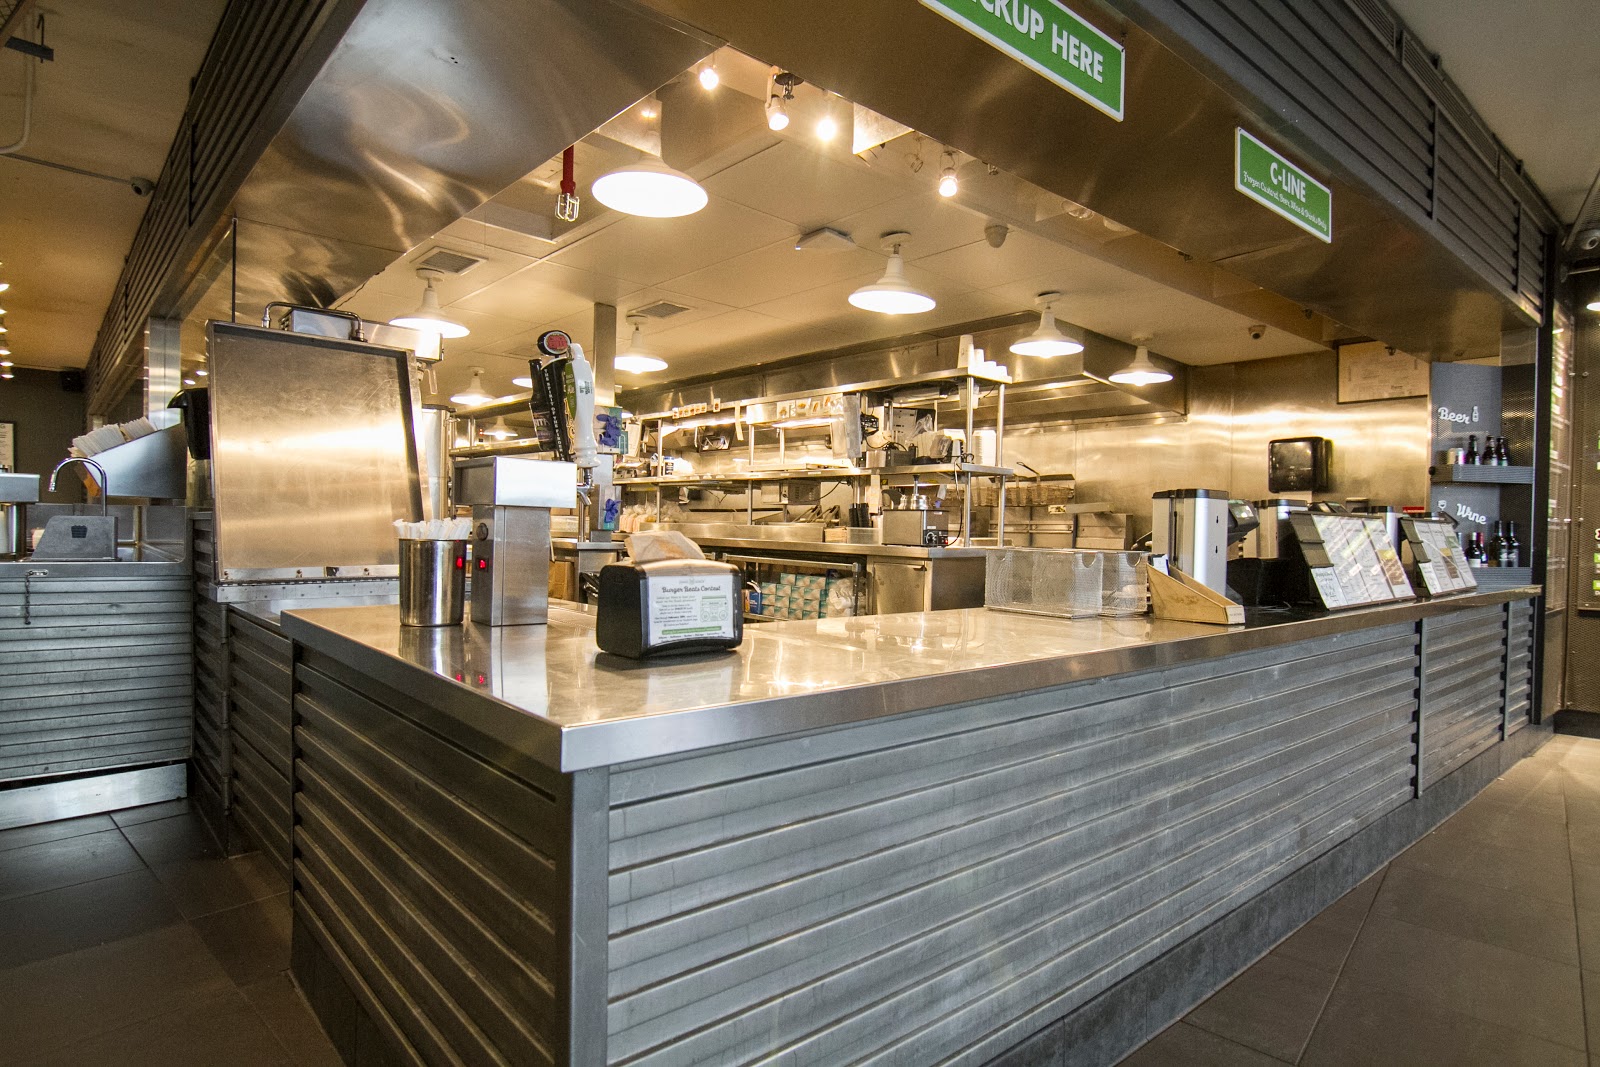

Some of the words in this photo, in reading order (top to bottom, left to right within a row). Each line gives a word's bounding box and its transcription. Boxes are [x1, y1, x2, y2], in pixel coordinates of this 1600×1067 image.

[1051, 23, 1104, 84] HERE
[1243, 170, 1260, 188] Frozen
[1260, 182, 1280, 201] Custard,
[1279, 194, 1290, 207] Beer,
[1290, 199, 1301, 213] Wine
[1270, 162, 1306, 203] C-LINE
[546, 382, 554, 406] SPIRIT
[1438, 407, 1470, 424] Beer
[1456, 503, 1487, 525] Wine
[662, 586, 683, 594] Burger
